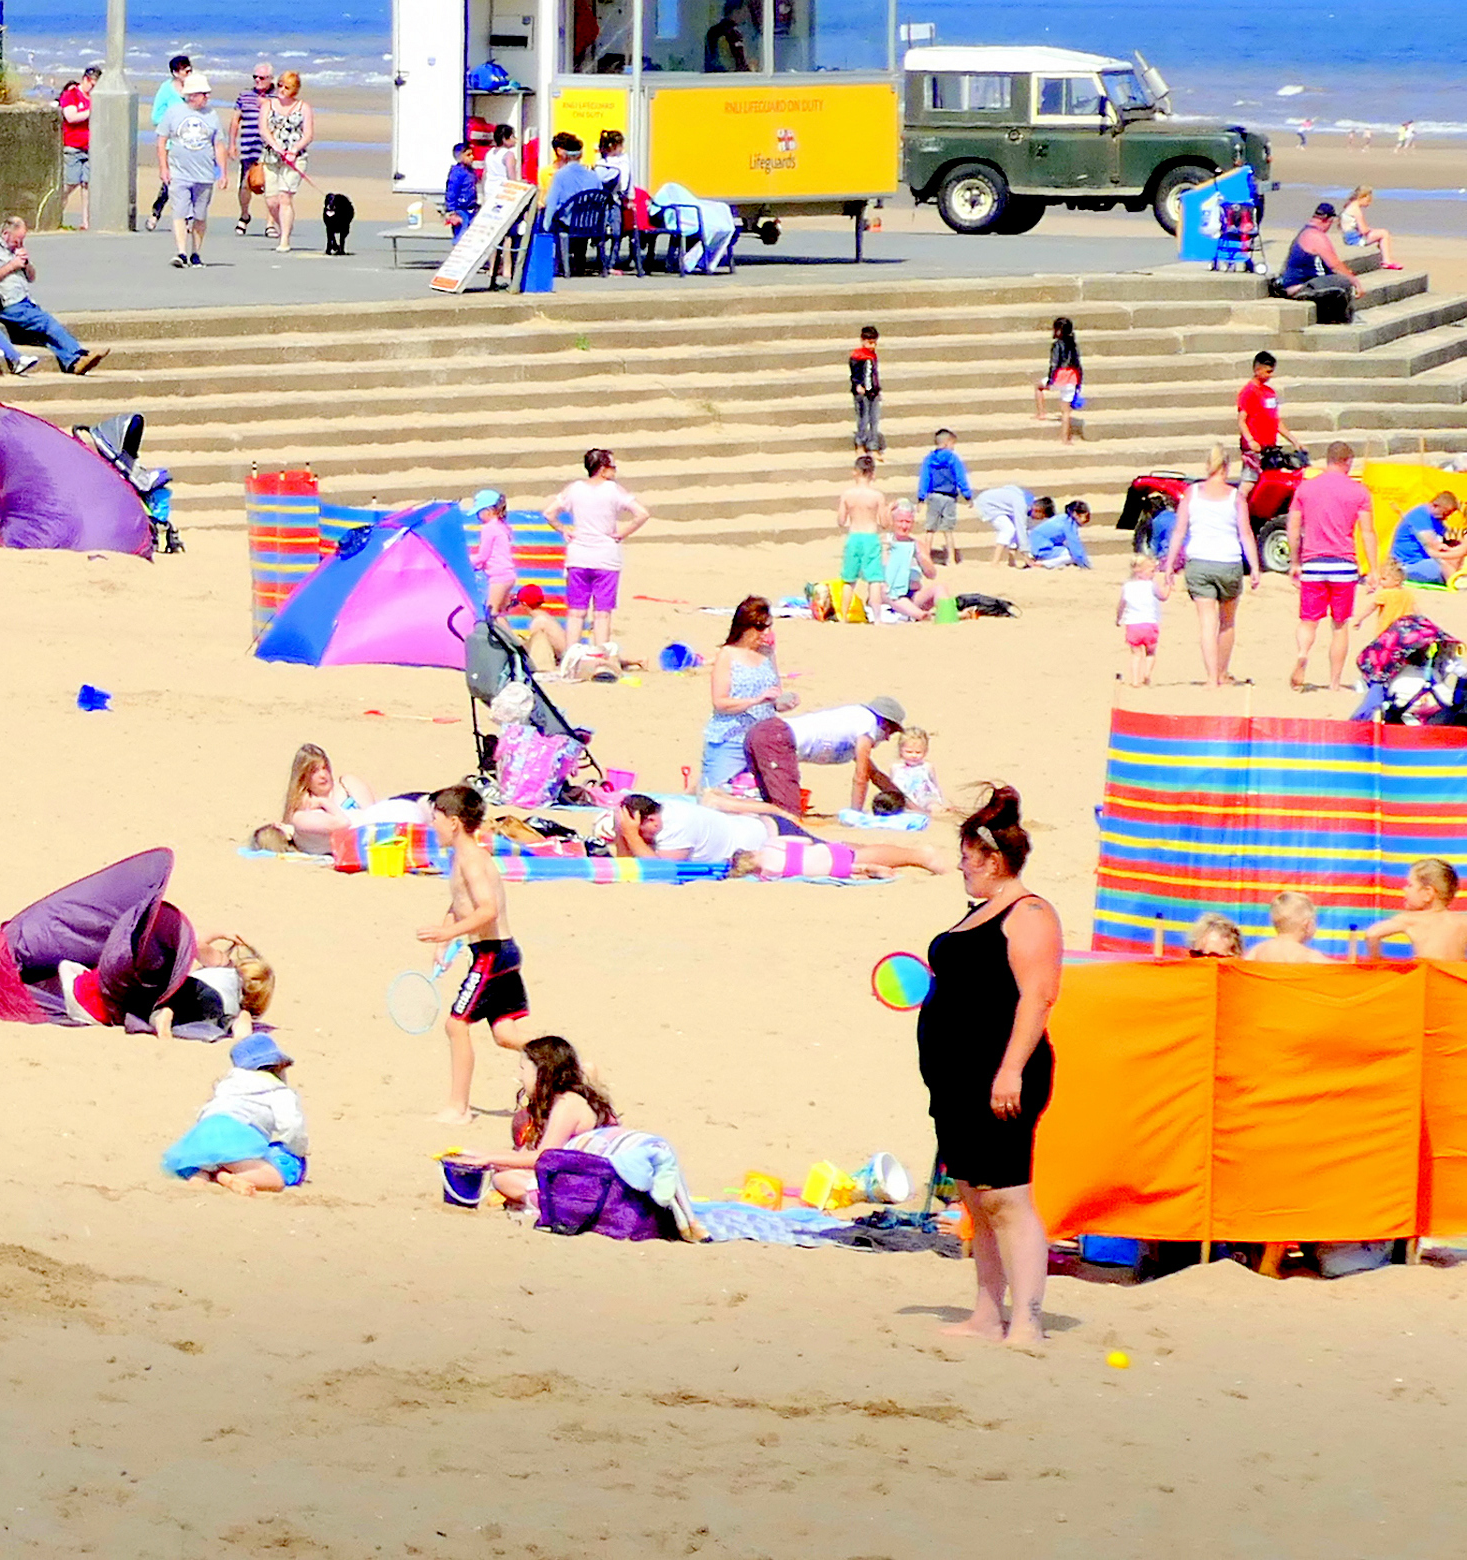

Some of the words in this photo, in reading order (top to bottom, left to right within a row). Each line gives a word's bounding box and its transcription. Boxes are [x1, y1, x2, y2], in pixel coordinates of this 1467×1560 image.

[744, 100, 787, 113] LIFEGUARD
[788, 100, 800, 111] ON
[802, 99, 823, 111] DUTY
[750, 153, 796, 174] Lifeguards
